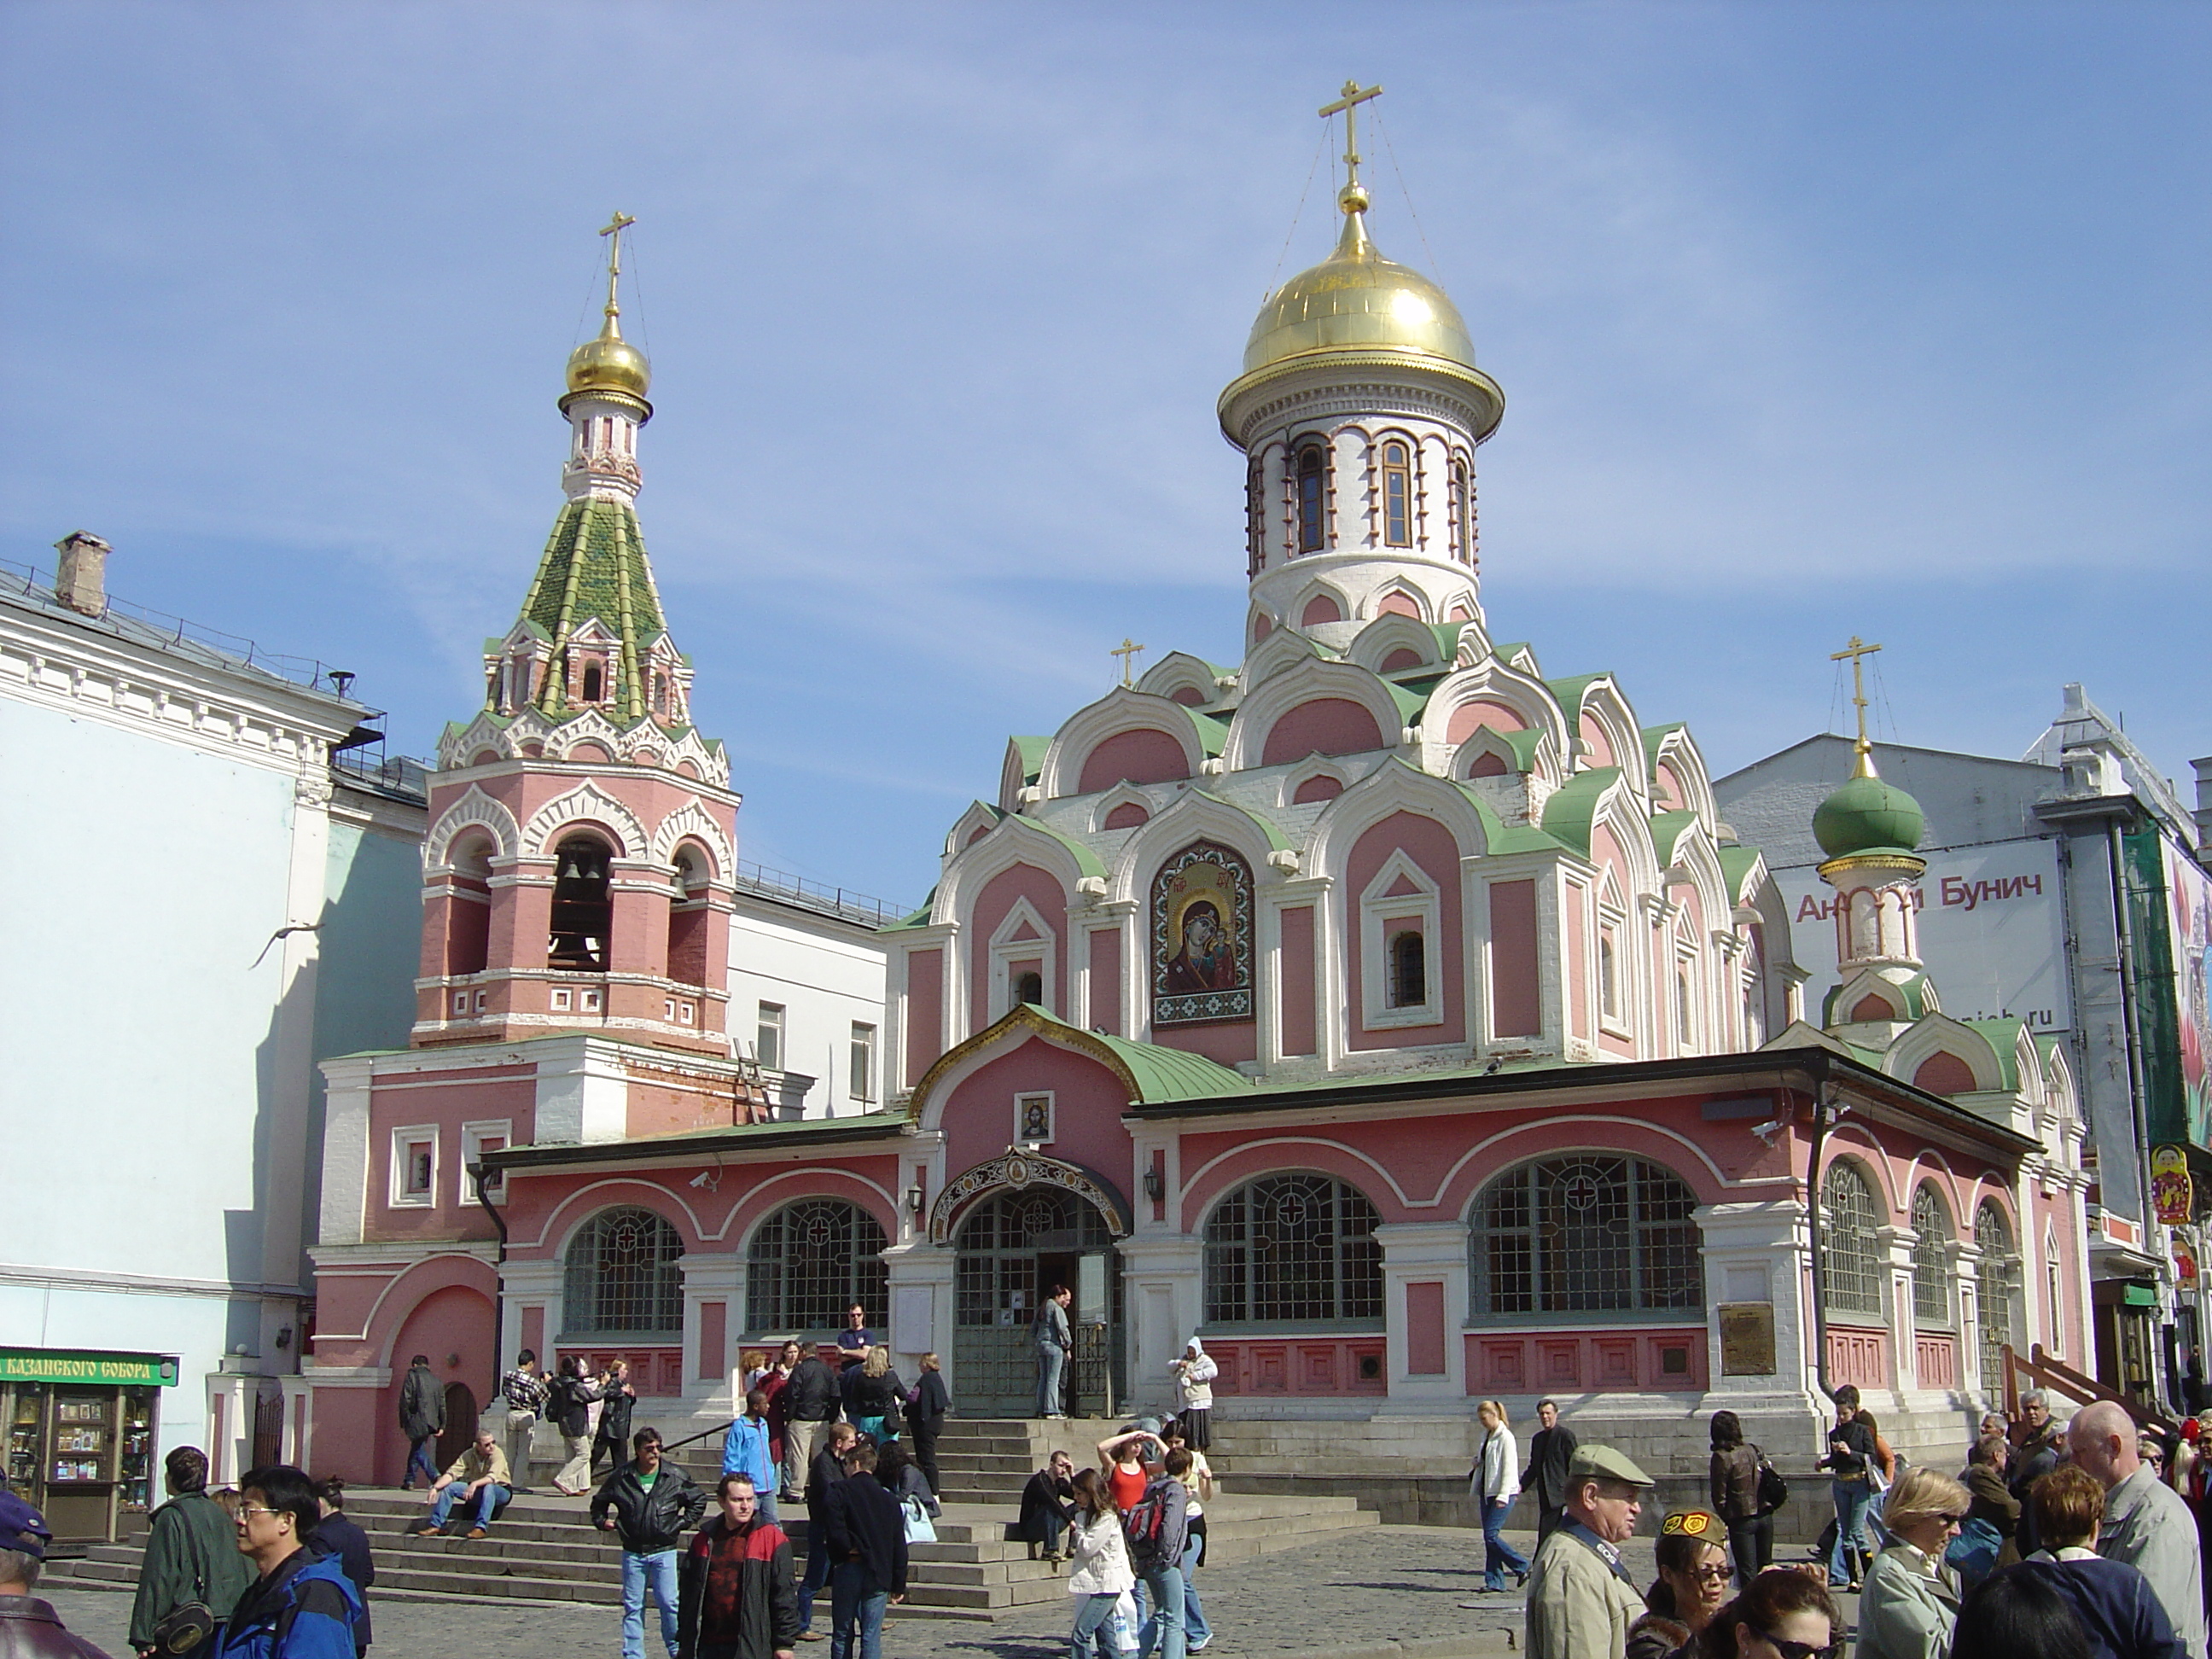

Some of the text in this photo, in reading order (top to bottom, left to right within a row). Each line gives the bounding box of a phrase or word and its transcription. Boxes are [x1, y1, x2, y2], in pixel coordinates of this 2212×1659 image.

[1941, 874, 2042, 911] Бунич
[7, 1358, 96, 1377] КАЗАНСКОГО
[101, 1361, 151, 1378] СОБОРА
[1596, 1543, 1617, 1565] EOS
